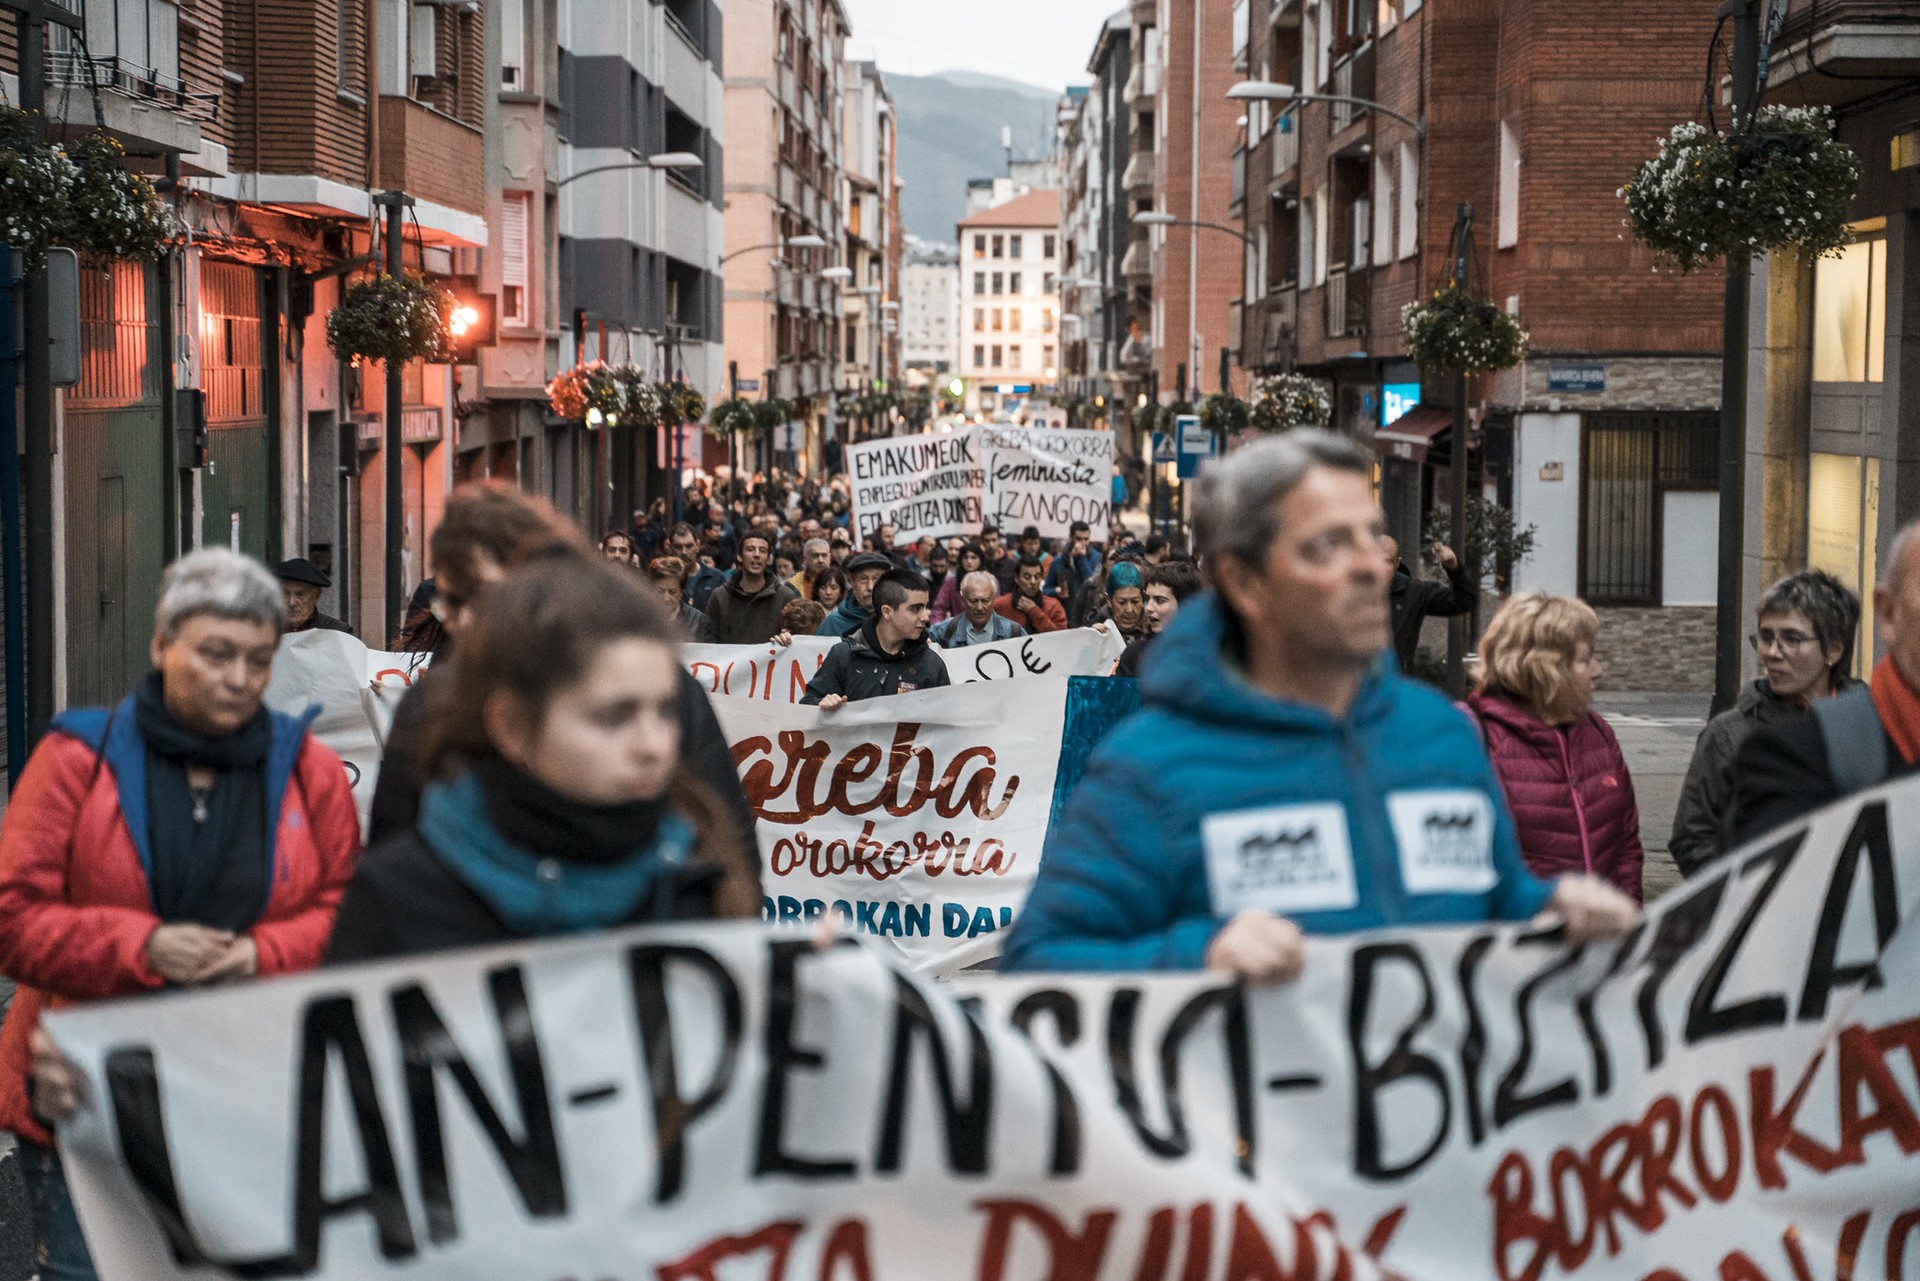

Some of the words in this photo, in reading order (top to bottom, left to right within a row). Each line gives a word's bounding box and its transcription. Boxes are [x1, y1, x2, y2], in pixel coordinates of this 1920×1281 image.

[856, 434, 974, 479] EMAKUMEOK
[1038, 434, 1113, 460] OROKORRA
[989, 452, 1100, 494] feminista
[998, 489, 1086, 525] IZANGO
[771, 820, 1017, 881] orokorra
